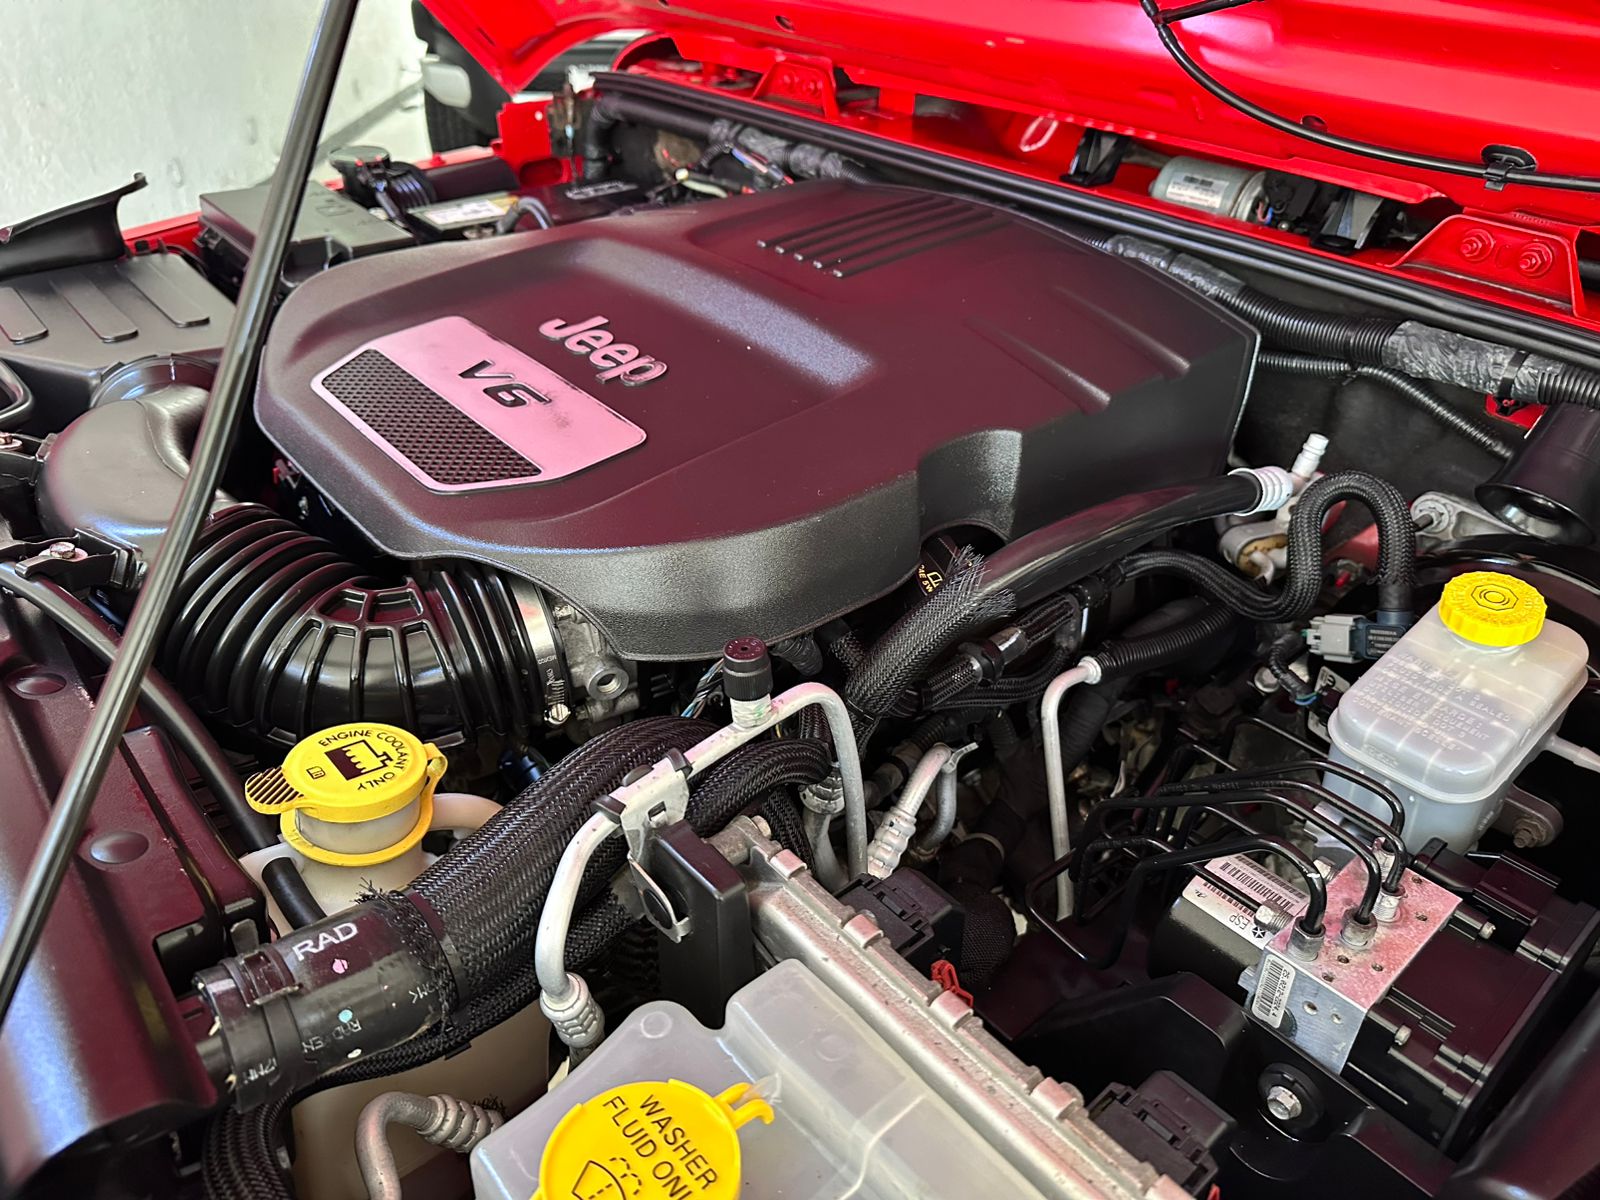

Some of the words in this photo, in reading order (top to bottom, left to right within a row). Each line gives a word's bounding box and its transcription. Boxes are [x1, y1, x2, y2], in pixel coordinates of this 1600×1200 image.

[539, 316, 668, 386] Jeep
[458, 360, 552, 408] V6
[319, 730, 372, 747] ENGINE
[377, 732, 408, 770] COOLANT
[358, 772, 395, 790] ONLY
[1228, 913, 1250, 930] ESP
[292, 922, 358, 961] RAD
[603, 1095, 657, 1158] FLUID
[640, 1094, 718, 1190] WASHER
